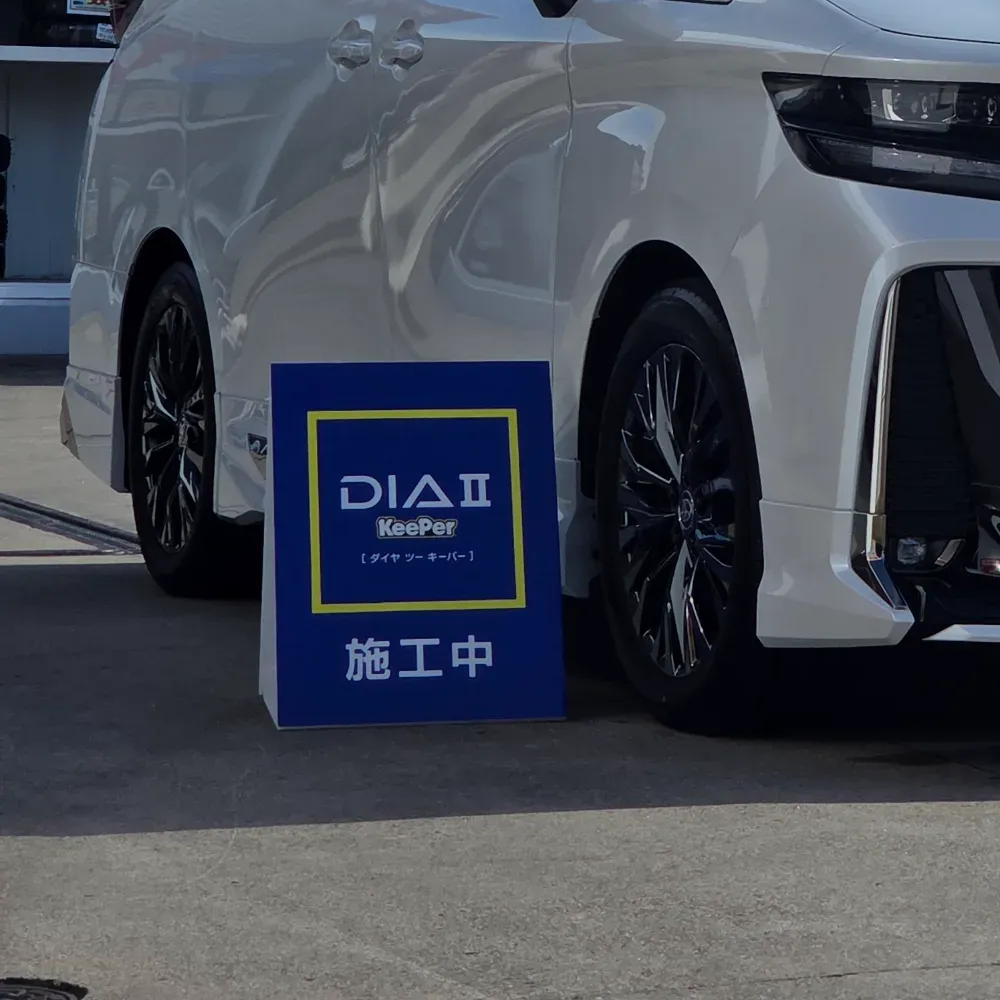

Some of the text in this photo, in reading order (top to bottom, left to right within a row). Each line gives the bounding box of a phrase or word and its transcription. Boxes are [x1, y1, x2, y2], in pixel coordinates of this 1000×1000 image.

[376, 516, 458, 539] KeePer
[345, 634, 493, 681] 施工中
